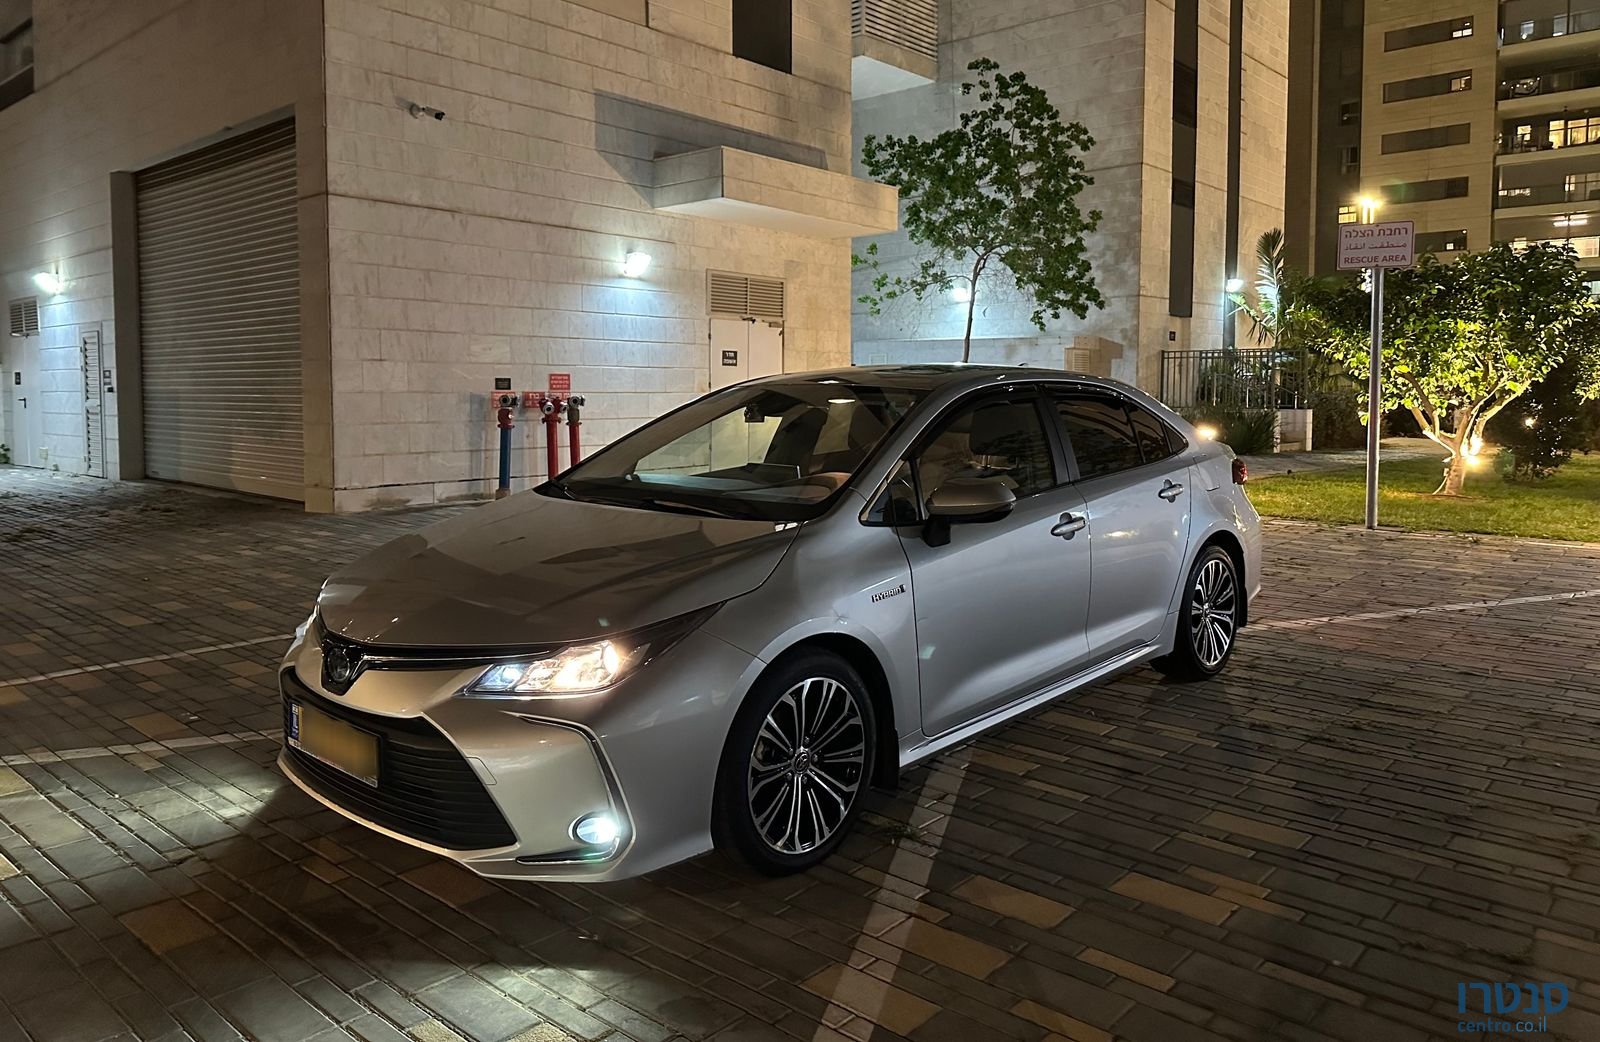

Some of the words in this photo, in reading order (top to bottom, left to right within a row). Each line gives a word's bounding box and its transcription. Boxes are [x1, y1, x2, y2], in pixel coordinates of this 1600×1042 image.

[1345, 227, 1374, 238] הצלה
[1377, 227, 1408, 237] רחבת
[1344, 255, 1379, 264] RESCUE
[1381, 254, 1407, 262] AREA
[871, 586, 901, 603] HYBRID
